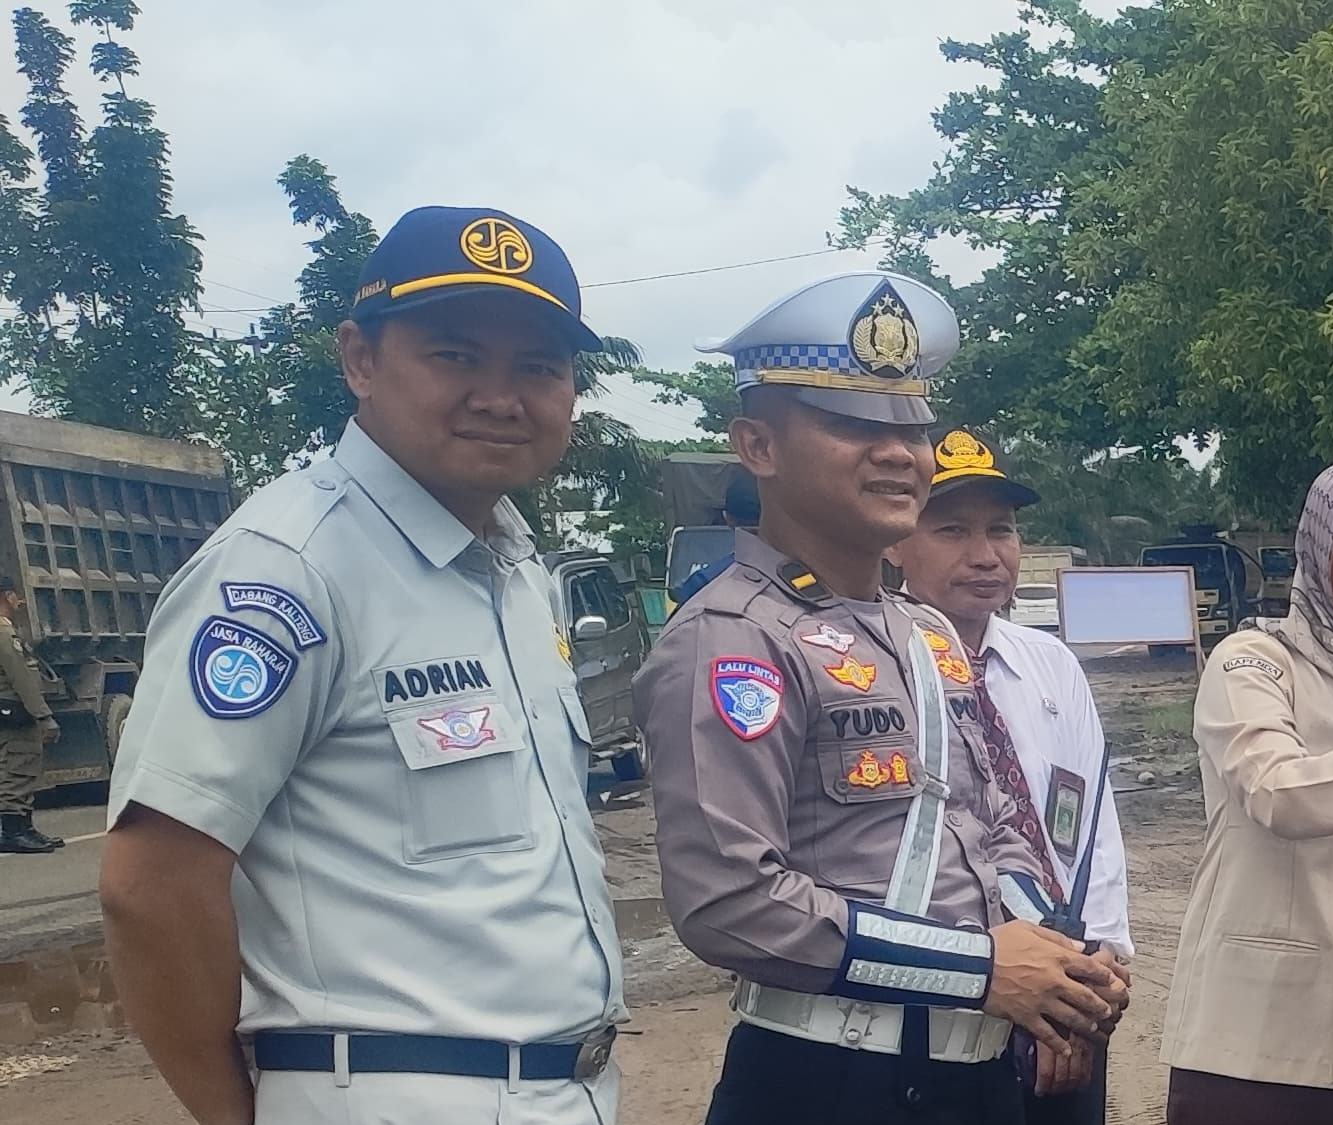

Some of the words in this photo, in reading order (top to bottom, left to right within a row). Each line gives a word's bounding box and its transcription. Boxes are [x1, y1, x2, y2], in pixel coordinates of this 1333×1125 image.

[278, 600, 315, 641] KALTENG
[211, 626, 240, 644] JASA
[241, 636, 287, 675] RAHARJA
[385, 660, 492, 703] ADRIAN
[718, 662, 747, 673] LALU
[747, 663, 780, 686] LINTAS
[830, 705, 905, 738] YUDO
